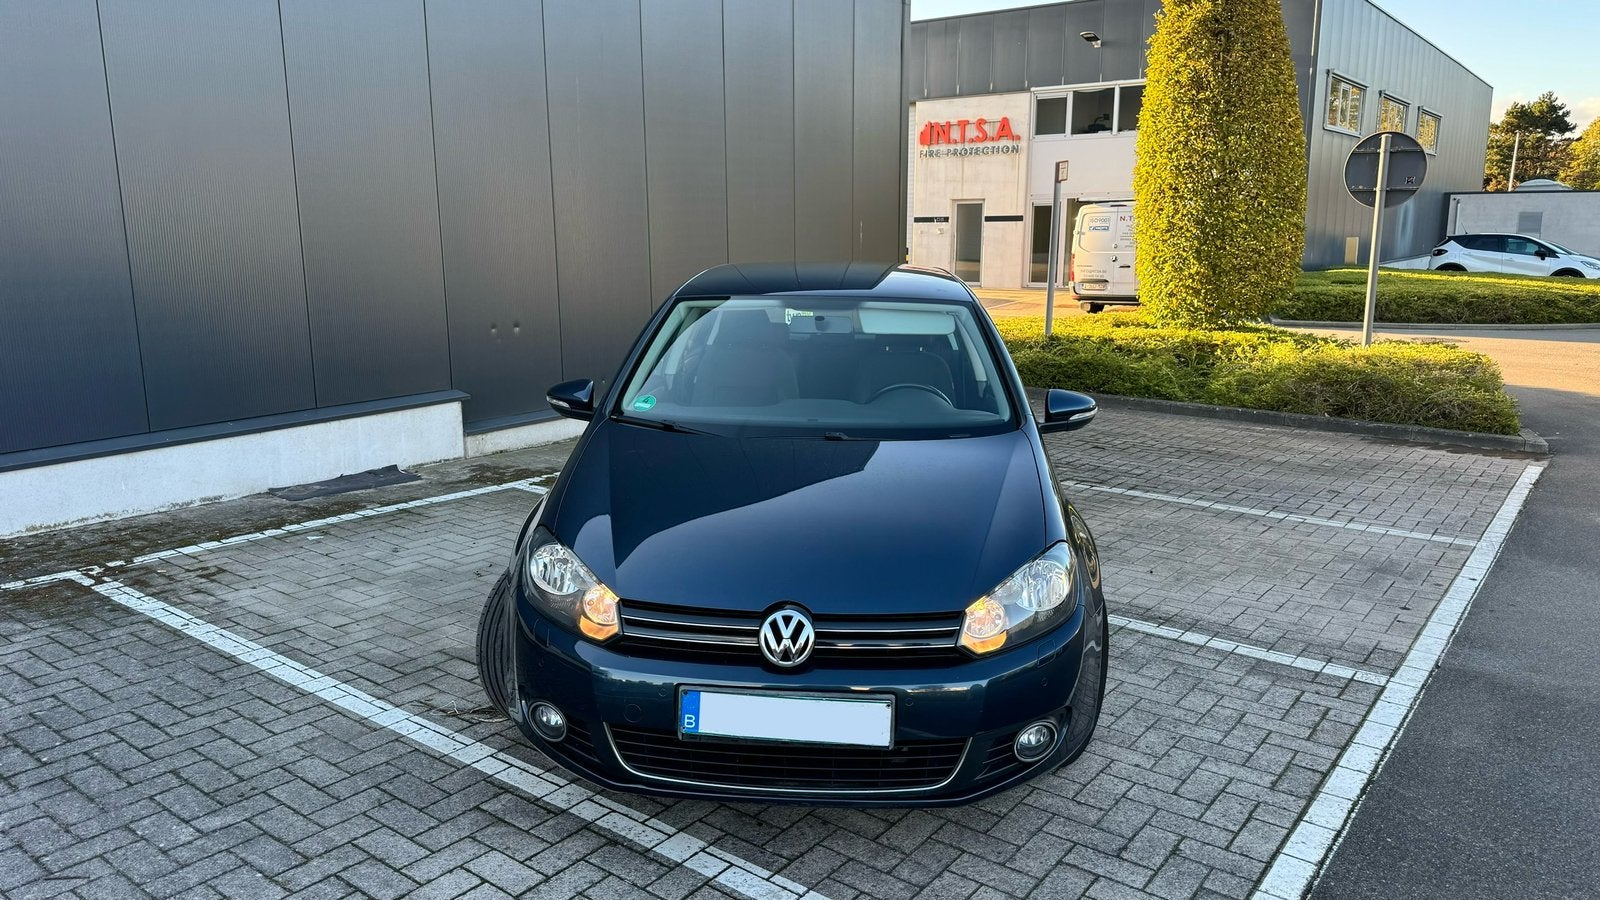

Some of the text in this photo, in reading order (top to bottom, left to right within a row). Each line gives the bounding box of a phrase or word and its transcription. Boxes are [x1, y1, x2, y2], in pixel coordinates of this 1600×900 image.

[933, 116, 1021, 145] N.T.S.A.
[919, 144, 1020, 159] FIRE PROTECTION
[684, 714, 696, 728] B
